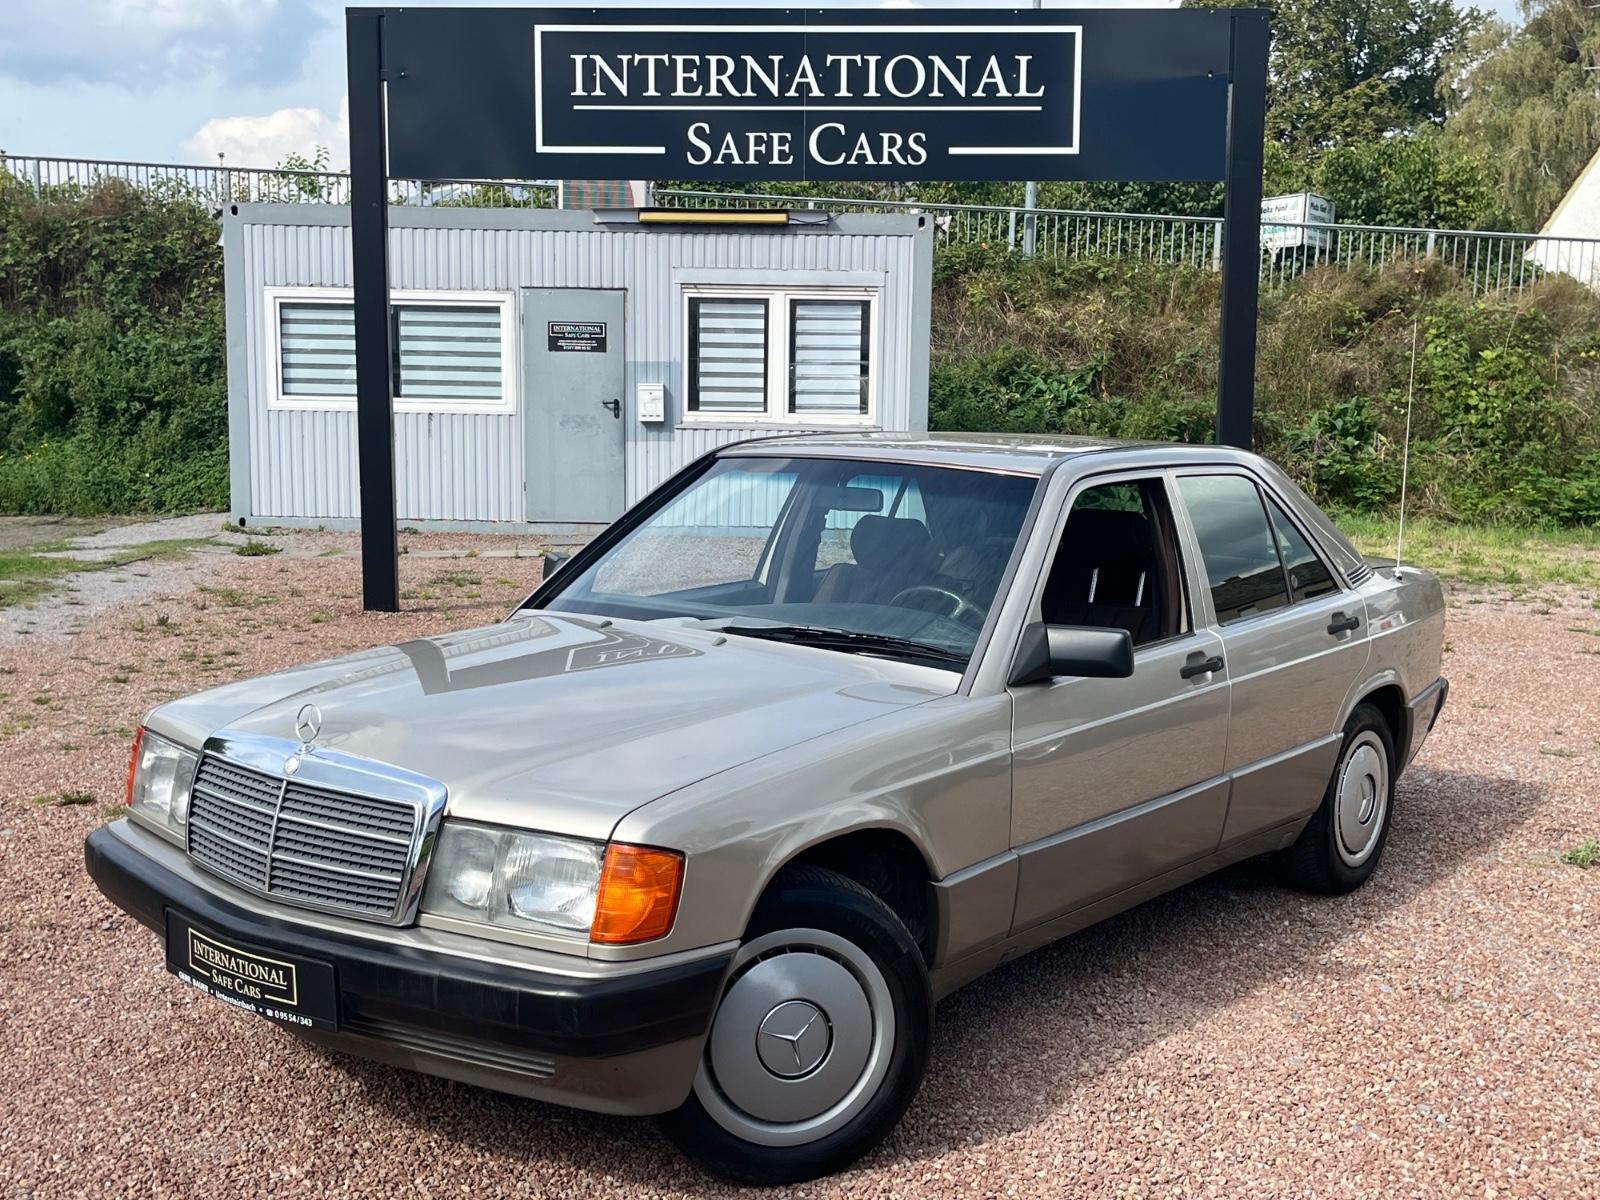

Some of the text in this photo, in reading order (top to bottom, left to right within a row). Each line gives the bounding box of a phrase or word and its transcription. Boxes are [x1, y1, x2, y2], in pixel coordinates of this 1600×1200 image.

[570, 53, 1045, 99] INTERNATIONAL
[686, 122, 928, 166] SAFE CARS
[193, 939, 288, 985] INTERNATIONAL
[212, 968, 261, 999] SAFE CARS
